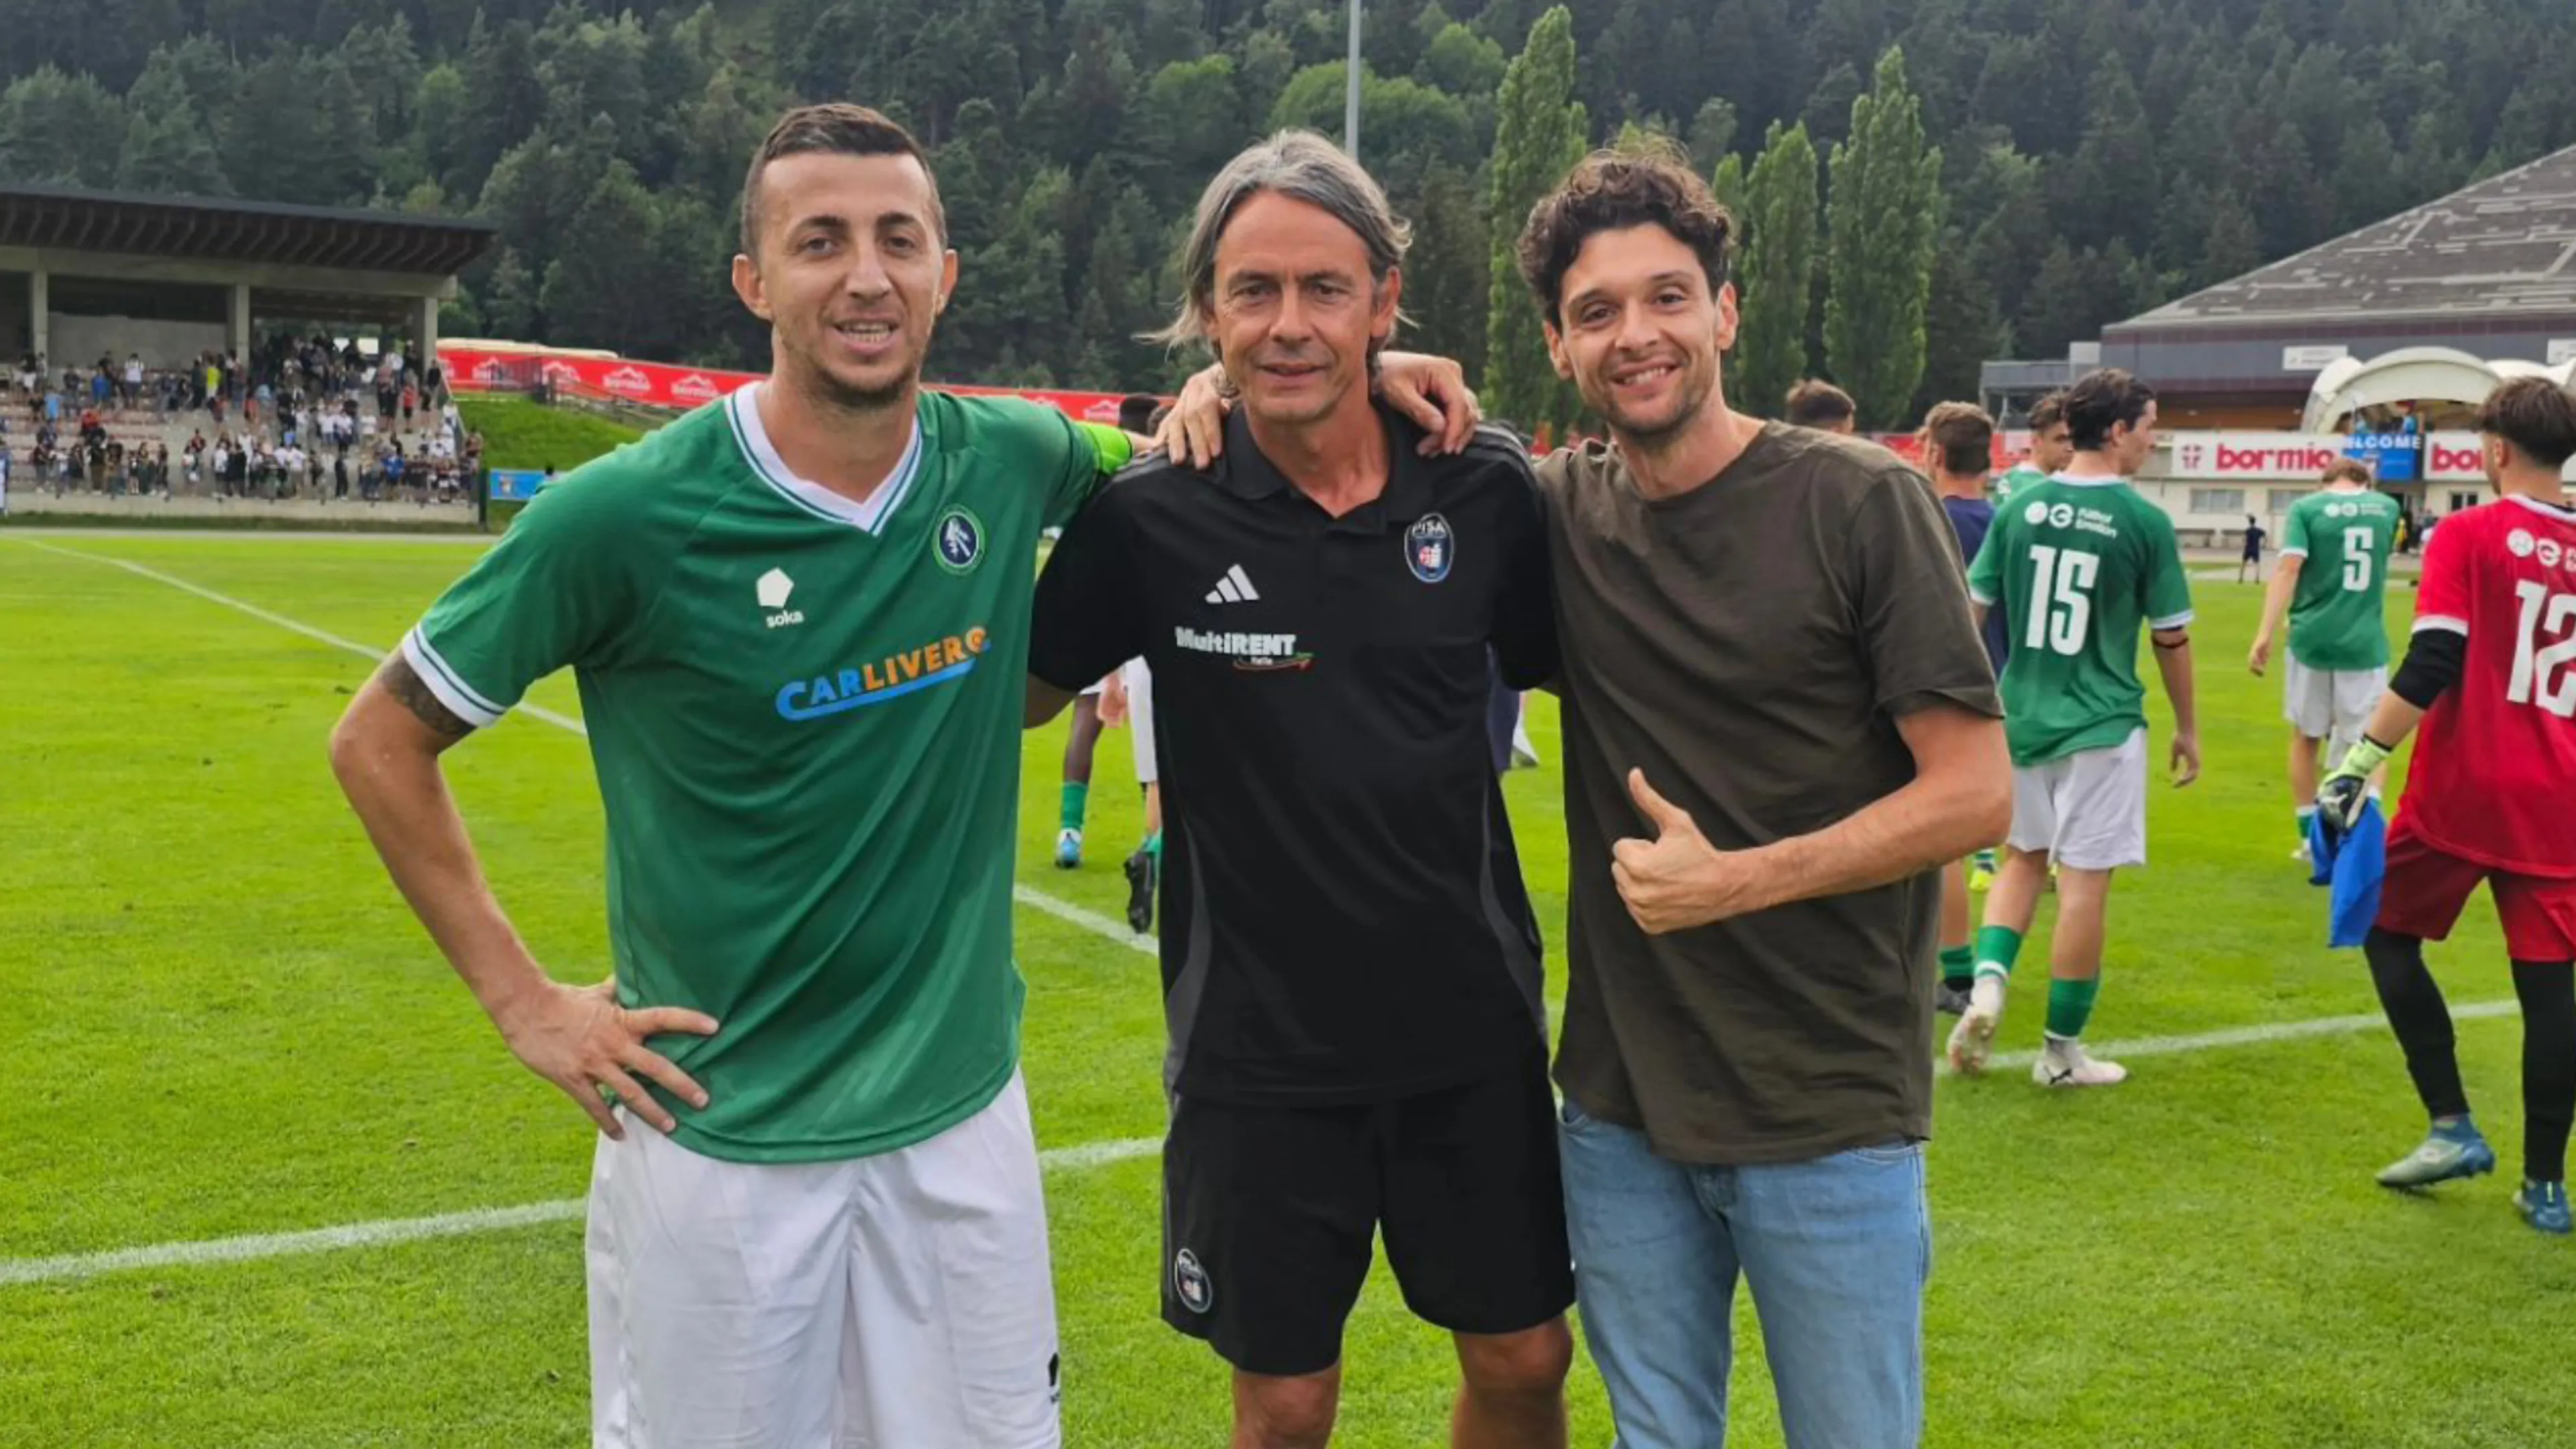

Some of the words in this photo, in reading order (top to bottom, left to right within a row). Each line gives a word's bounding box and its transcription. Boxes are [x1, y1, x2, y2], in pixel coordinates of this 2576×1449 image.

[2217, 442, 2334, 471] bormio
[2343, 527, 2374, 592] 5
[766, 609, 804, 628] soka
[2025, 545, 2100, 655] 15
[1175, 627, 1297, 655] MultiRENT
[2507, 579, 2576, 718] 12
